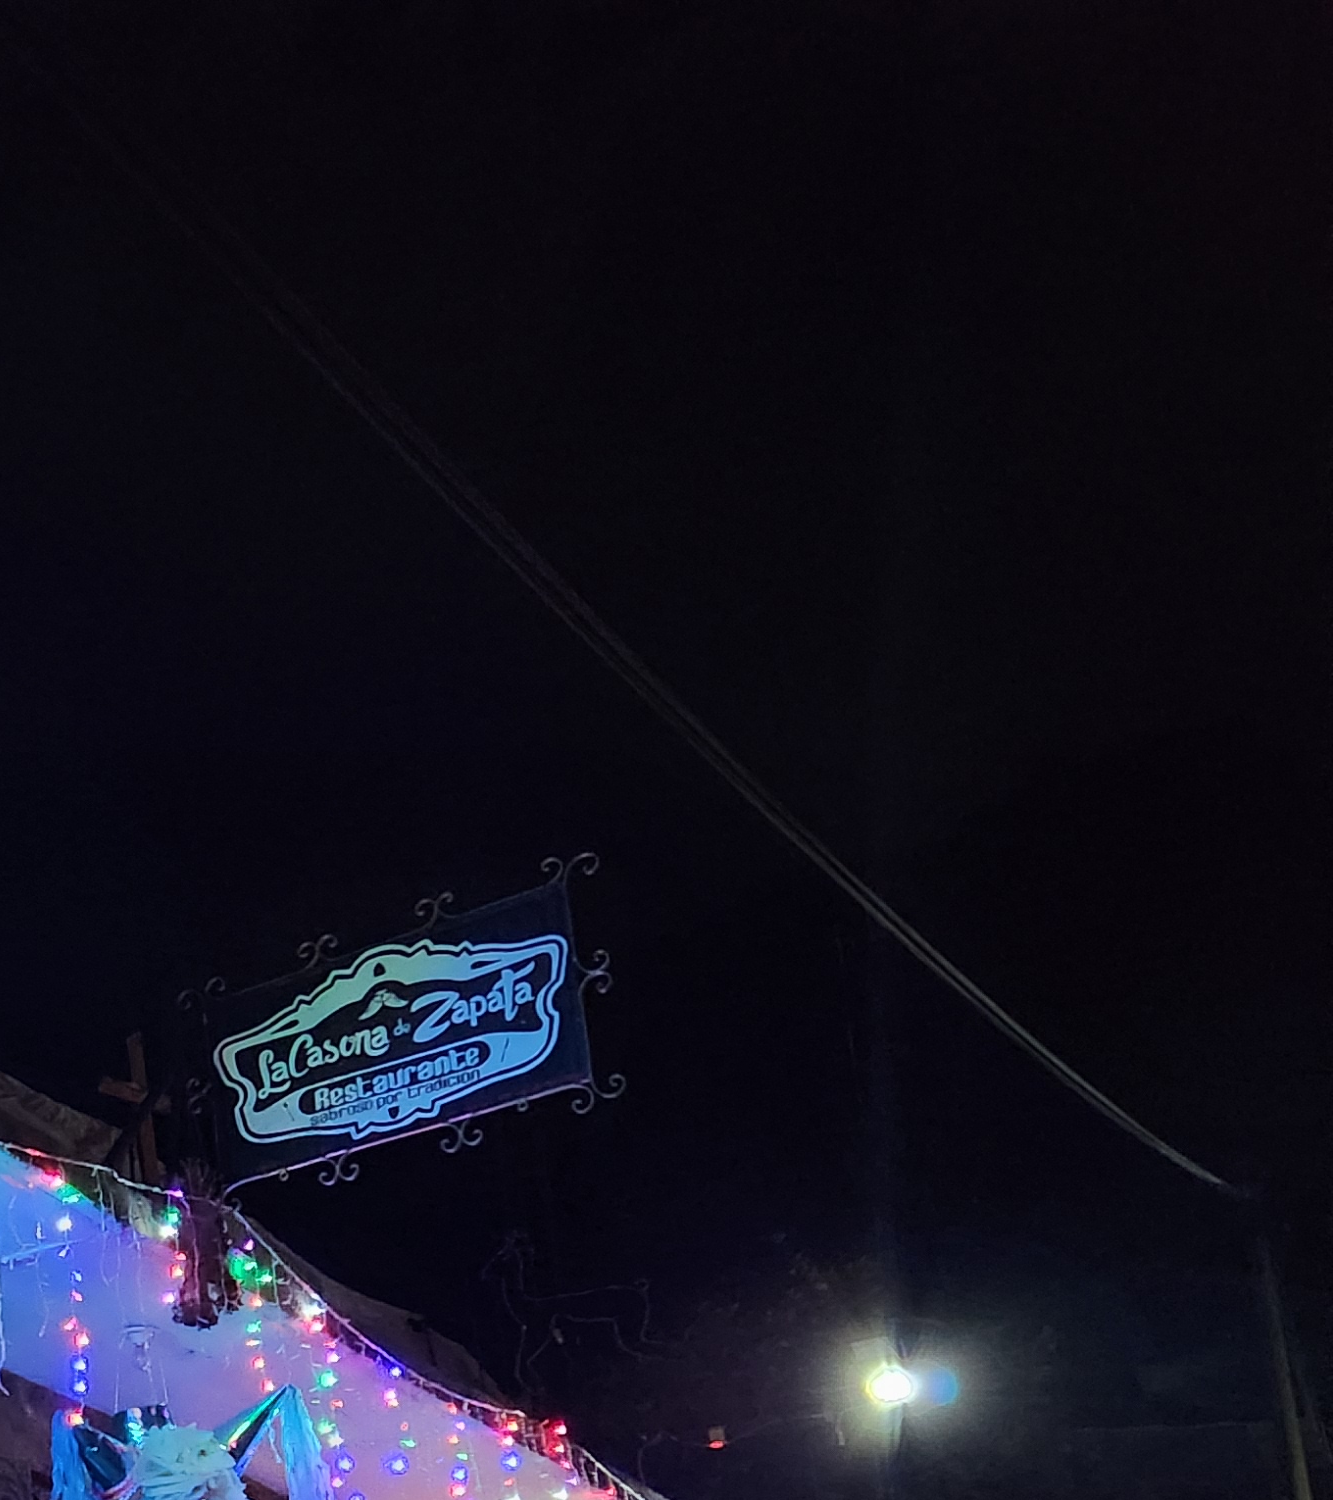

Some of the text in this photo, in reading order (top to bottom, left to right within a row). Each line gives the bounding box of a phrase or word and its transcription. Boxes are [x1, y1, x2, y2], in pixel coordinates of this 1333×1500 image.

[258, 1049, 292, 1099] La
[289, 1033, 390, 1077] Casona
[410, 961, 535, 1043] Zapata
[310, 1100, 374, 1126] sabroso
[376, 1092, 400, 1111] por
[314, 1046, 480, 1111] Restaurante
